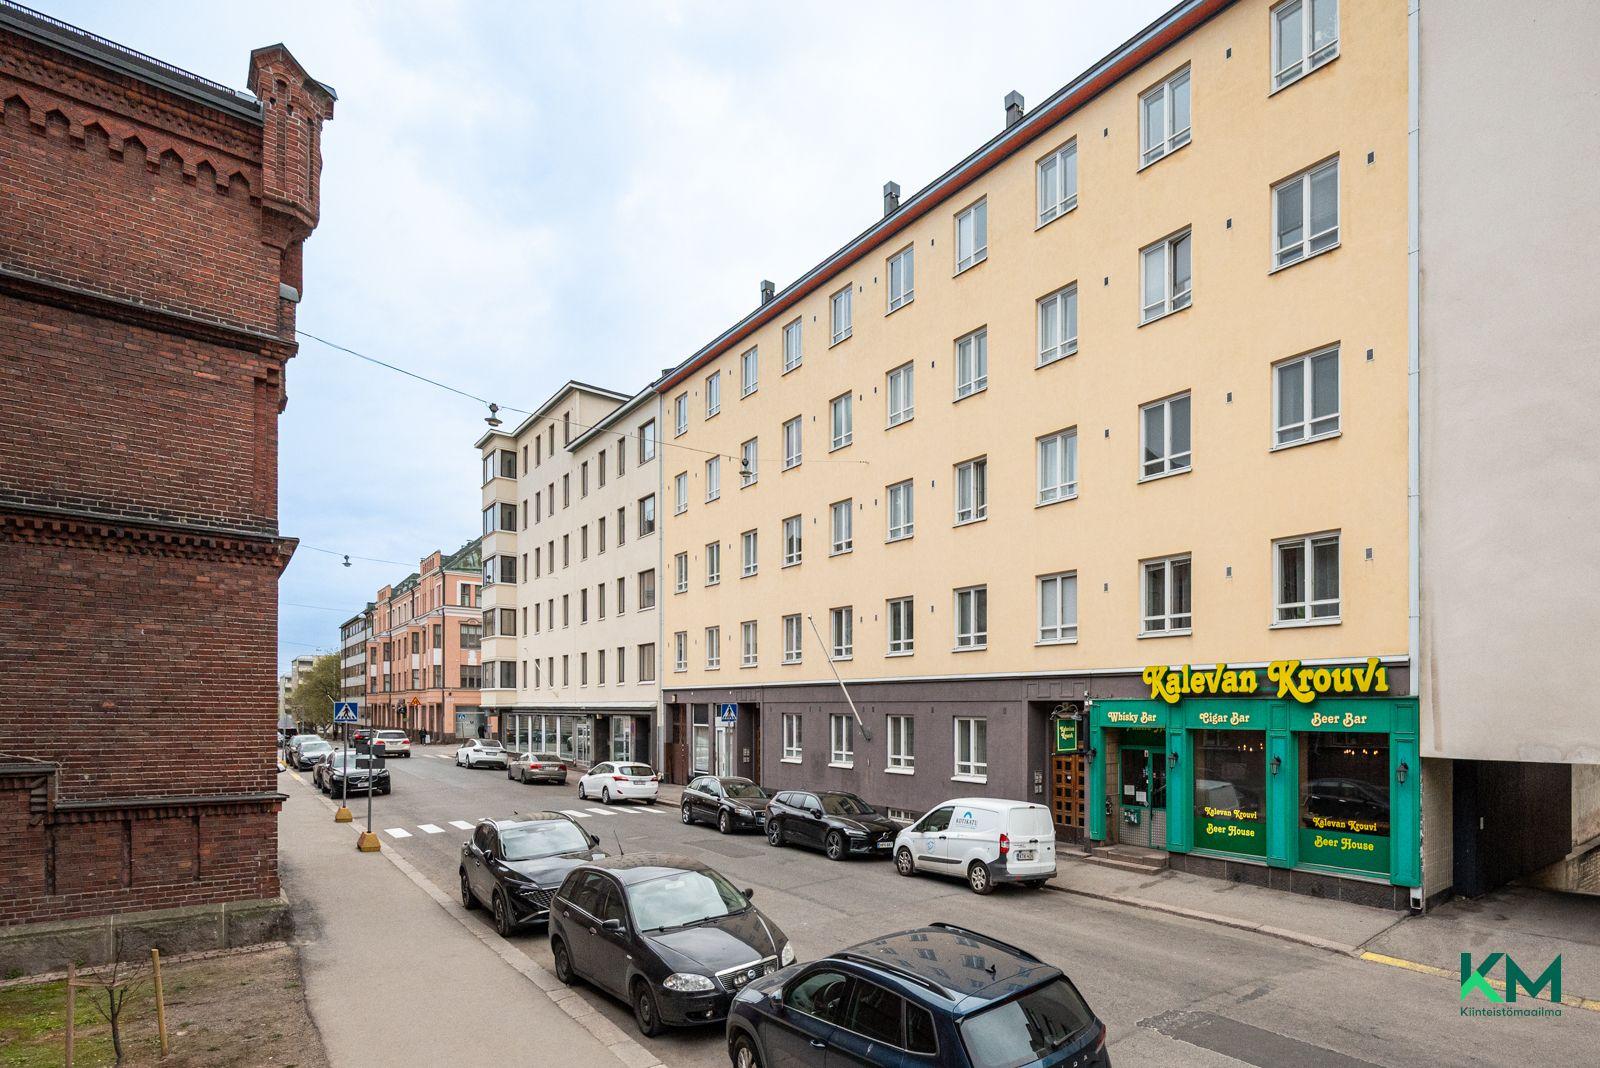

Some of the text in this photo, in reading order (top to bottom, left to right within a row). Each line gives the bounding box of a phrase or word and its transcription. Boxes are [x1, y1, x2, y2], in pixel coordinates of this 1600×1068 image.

[1142, 657, 1390, 704] Kalevan Krouvi
[1107, 711, 1157, 724] Whisky Bar
[1199, 711, 1250, 725] Cigar Bar
[1311, 712, 1367, 728] Beer Bar
[1204, 806, 1258, 820] Kalevan Krouvi
[1206, 823, 1256, 837] Beer House
[1312, 816, 1378, 833] Kalevan Krouvi
[1314, 835, 1375, 851] Beer House
